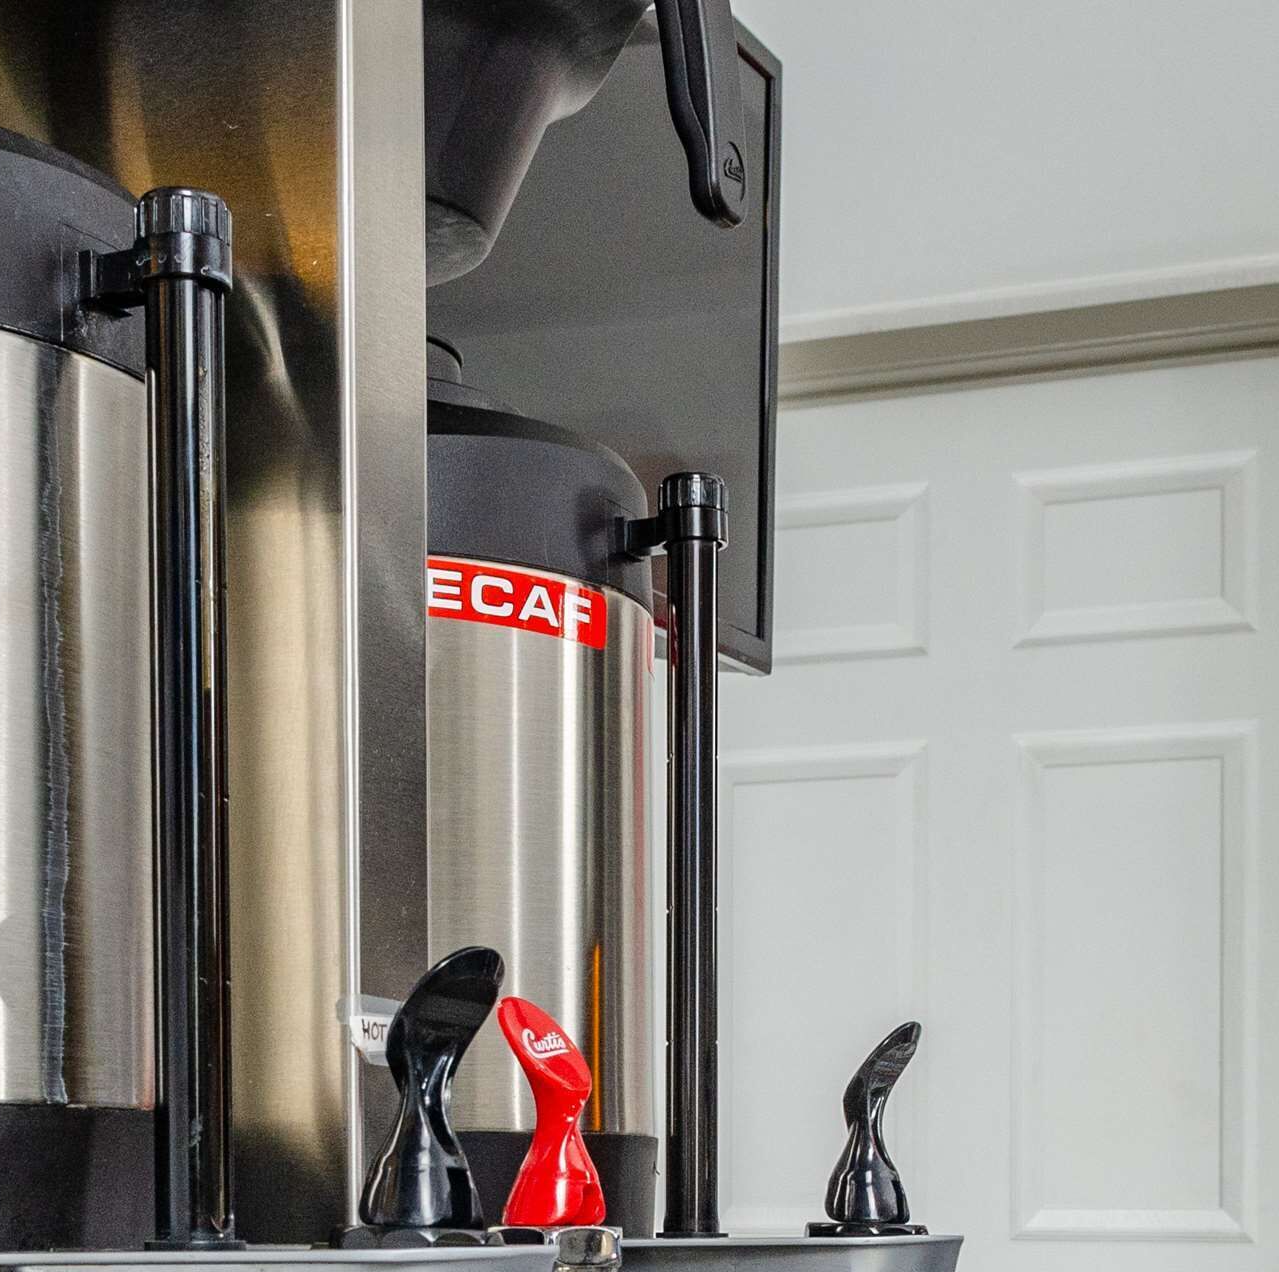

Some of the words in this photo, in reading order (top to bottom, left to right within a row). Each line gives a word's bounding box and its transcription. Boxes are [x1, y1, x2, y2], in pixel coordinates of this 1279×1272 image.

[426, 568, 592, 642] ECAF
[361, 1018, 388, 1042] HOT
[521, 1028, 570, 1060] Curtis
